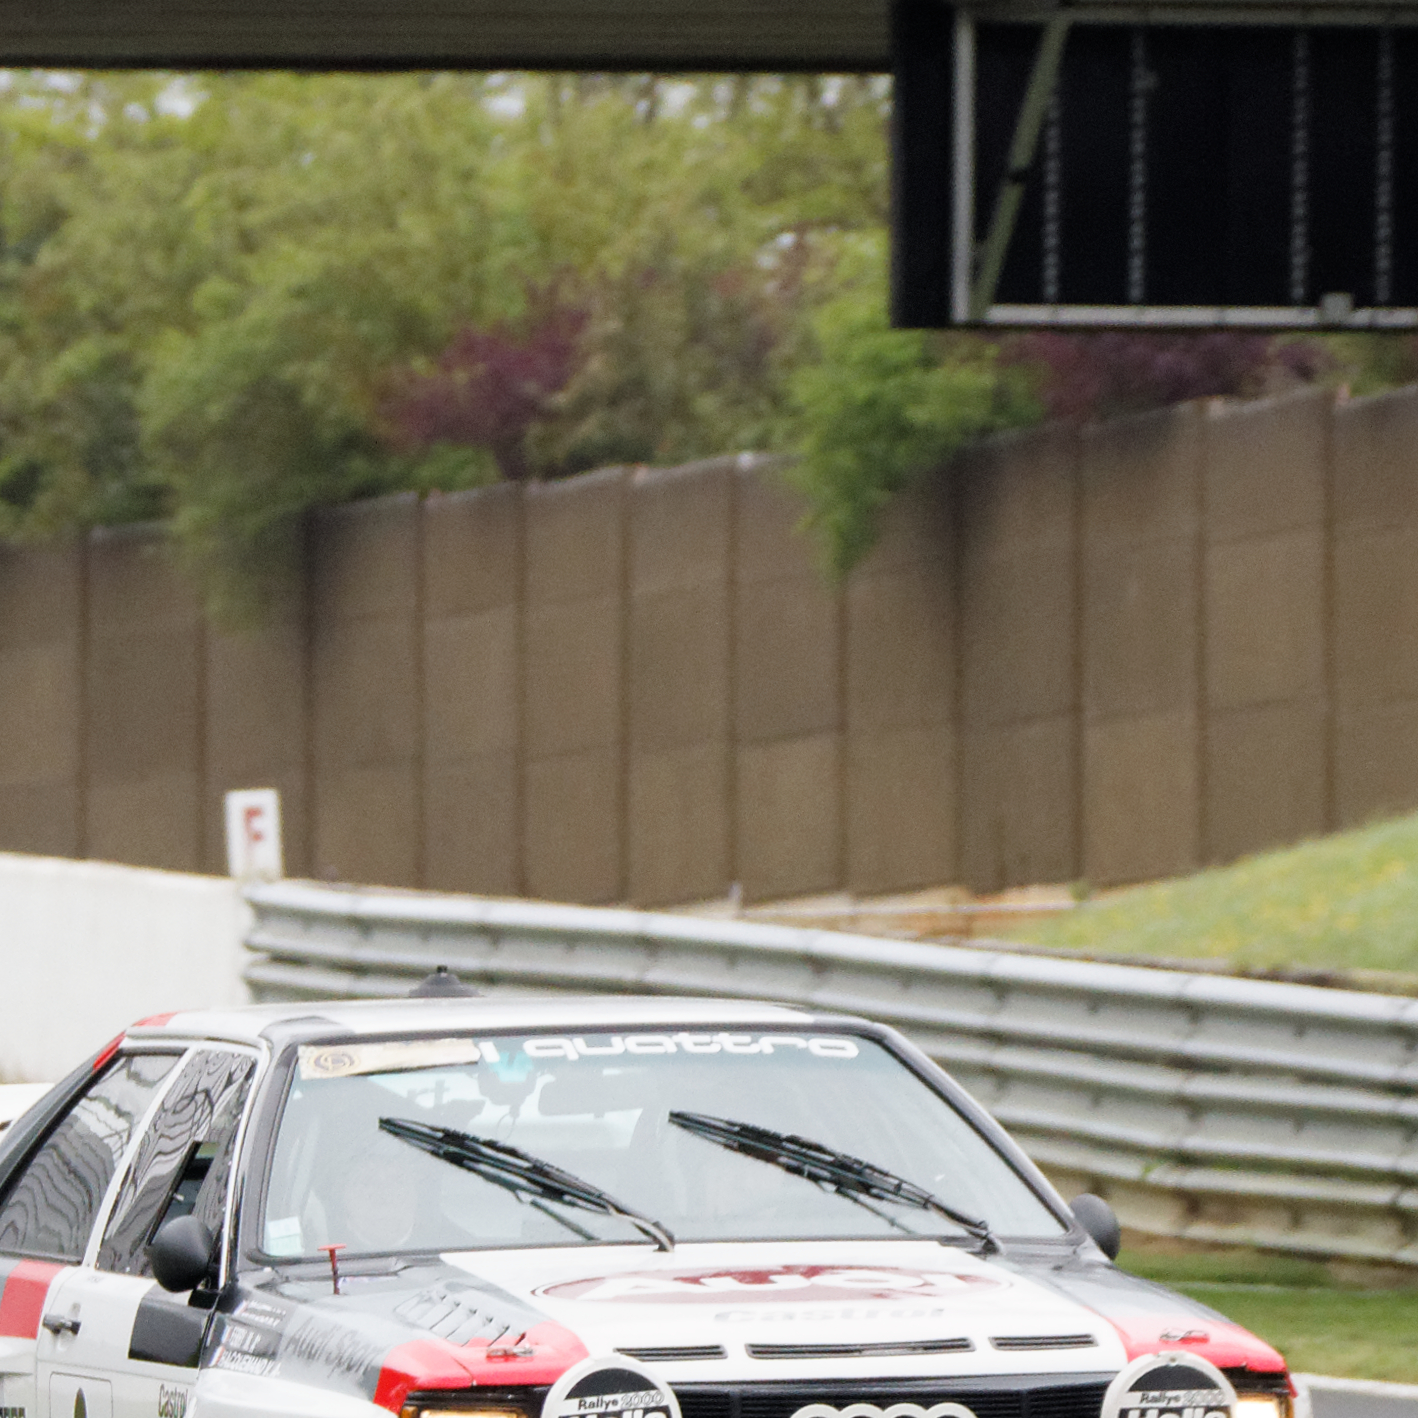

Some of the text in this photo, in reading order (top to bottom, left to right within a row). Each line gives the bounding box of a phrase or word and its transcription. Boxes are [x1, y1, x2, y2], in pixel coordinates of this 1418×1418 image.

[523, 1032, 860, 1061] quattro
[714, 1308, 945, 1323] Castrol
[578, 1390, 665, 1411] Rallye 2000
[1140, 1389, 1225, 1406] Rallye 2000
